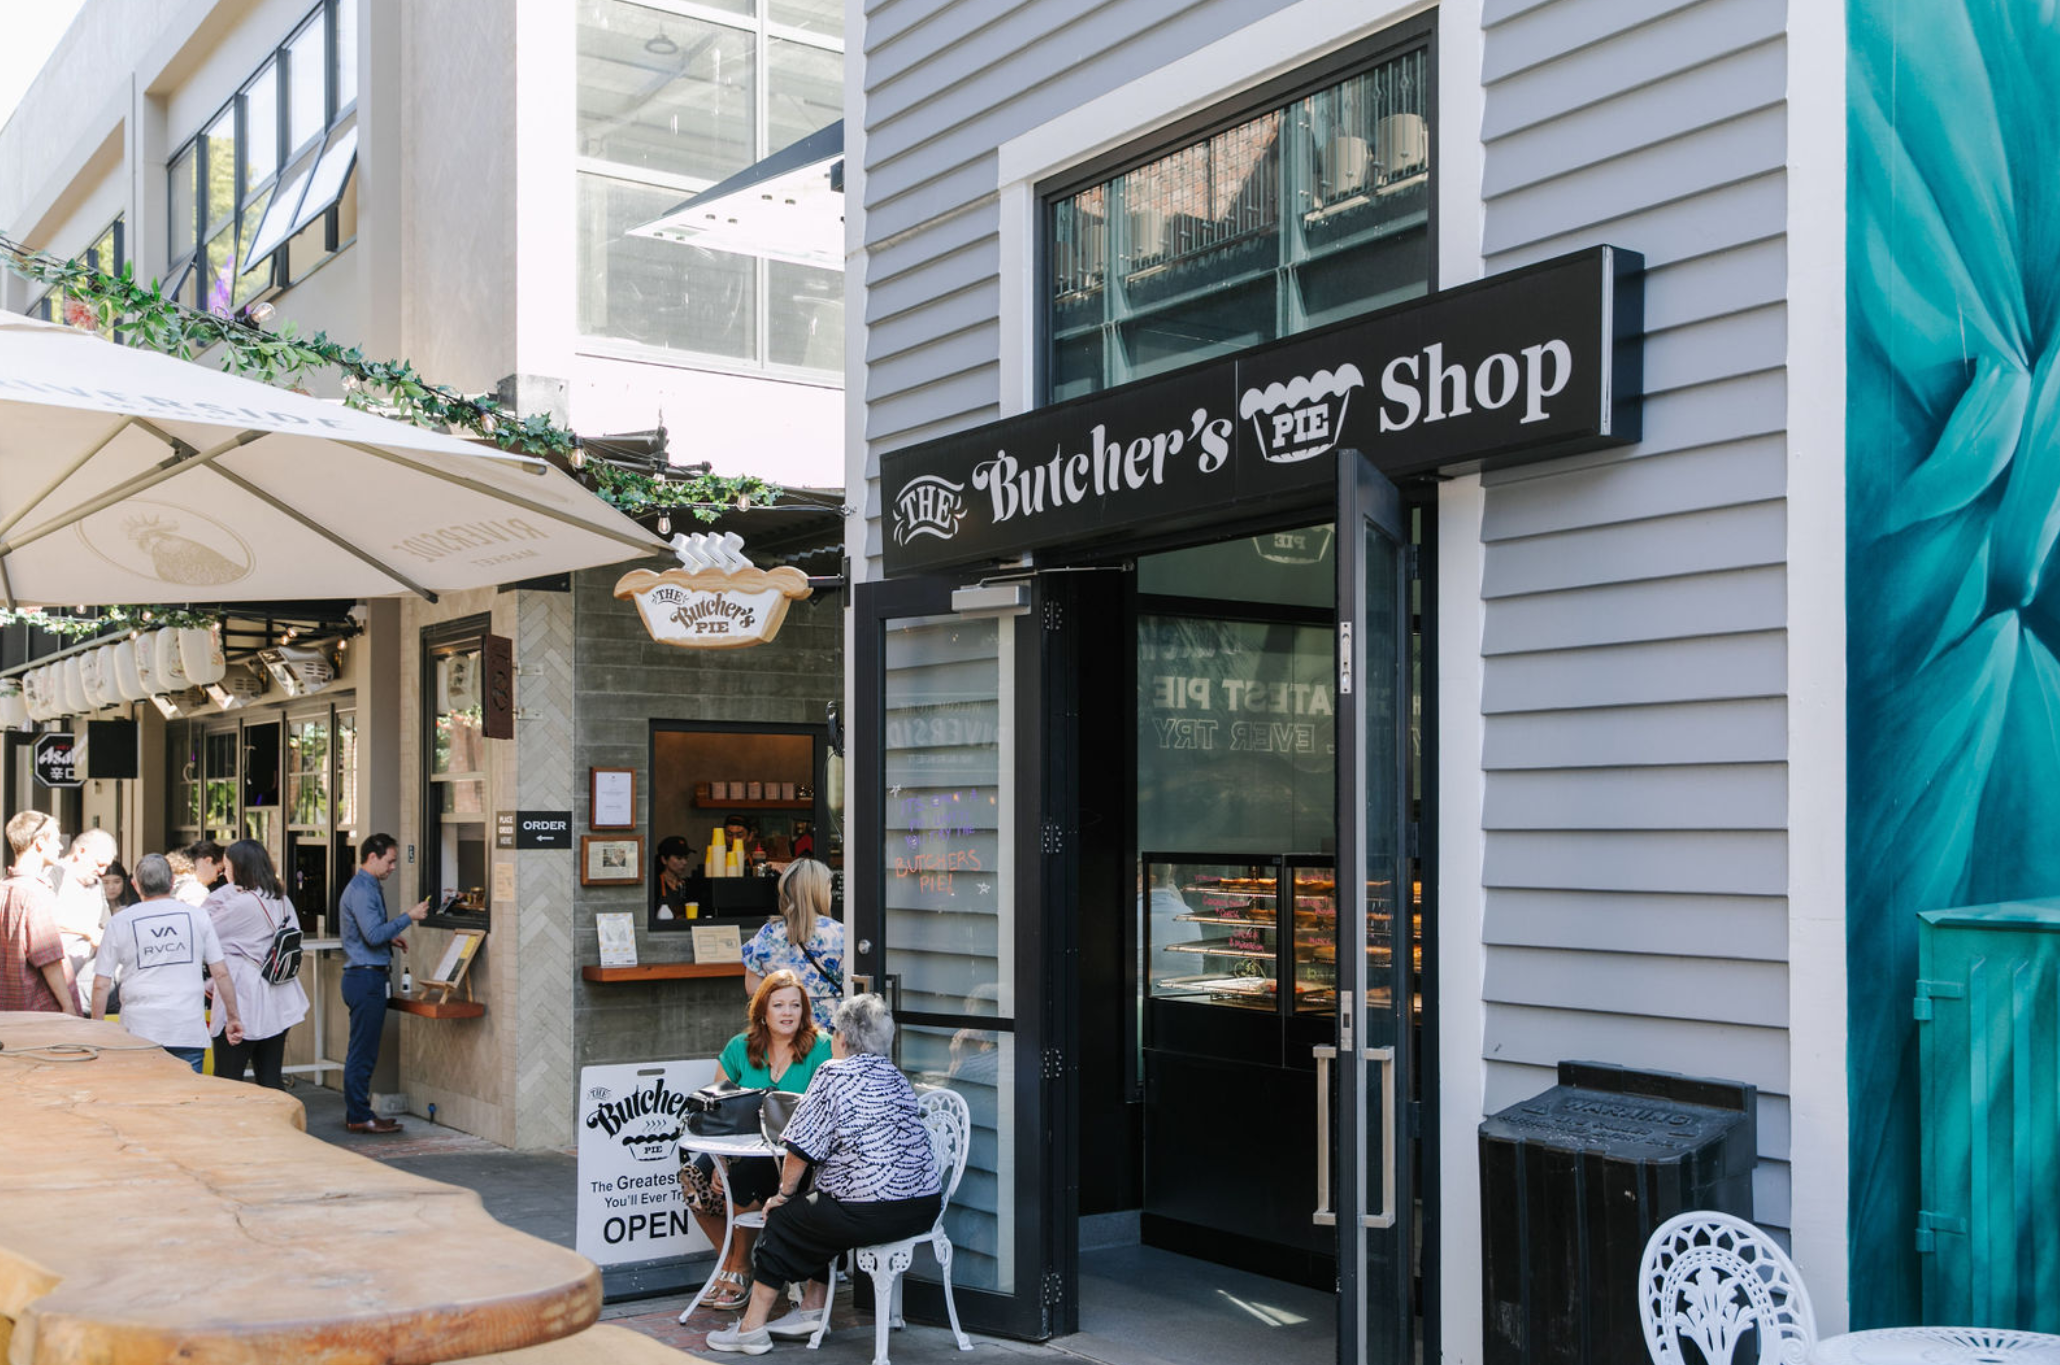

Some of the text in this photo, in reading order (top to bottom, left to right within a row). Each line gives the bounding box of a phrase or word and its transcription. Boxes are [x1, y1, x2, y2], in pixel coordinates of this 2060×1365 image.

[1271, 338, 1574, 450] PIE Shop
[899, 409, 1233, 530] THE Butcher's
[656, 588, 683, 603] THE
[670, 593, 756, 630] Butcher's
[695, 621, 730, 634] PIE
[522, 820, 567, 831] ORDER
[895, 849, 981, 878] BUTCHERS
[919, 873, 954, 895] PIE!
[150, 926, 178, 938] VA
[143, 941, 186, 956] RVCA
[643, 1145, 663, 1155] PIE
[591, 1173, 680, 1194] The Greatest
[604, 1193, 638, 1209] You'll
[641, 1191, 668, 1204] Ever
[603, 1209, 689, 1245] OPEN
